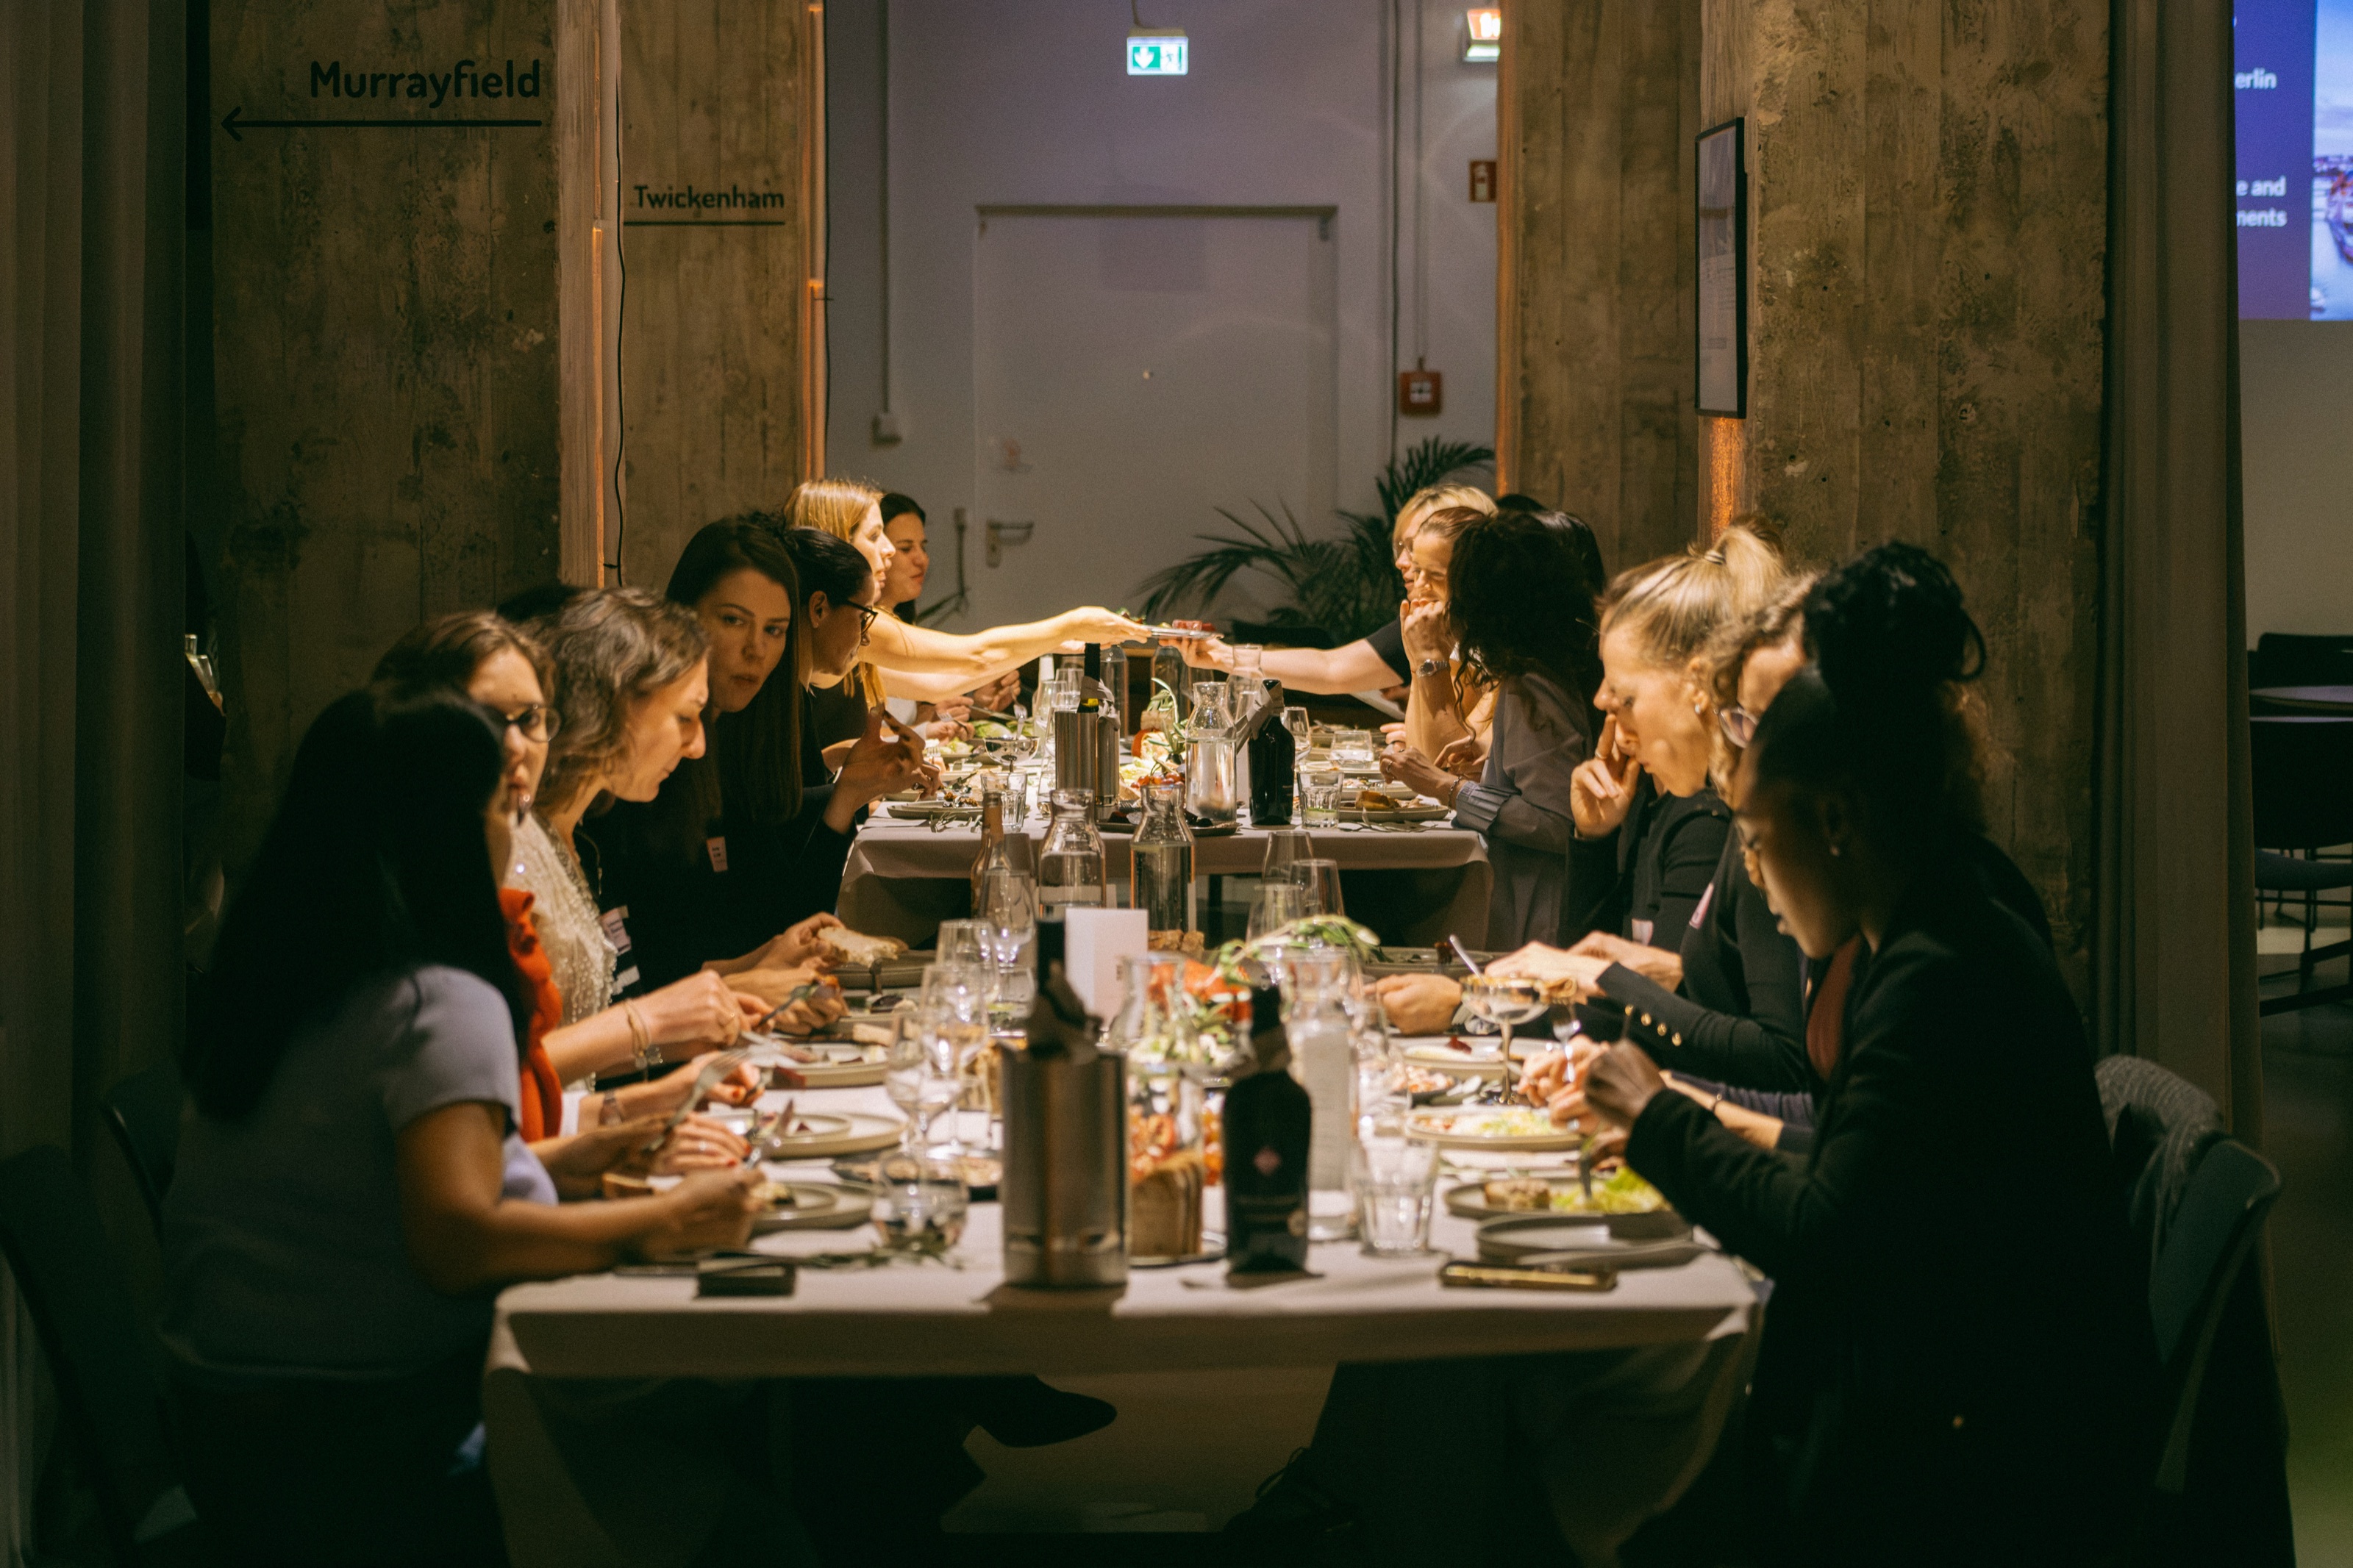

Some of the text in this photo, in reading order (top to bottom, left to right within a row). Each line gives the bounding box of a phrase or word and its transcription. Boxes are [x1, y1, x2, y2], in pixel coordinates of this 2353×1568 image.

[310, 59, 540, 109] Murrayfield
[2235, 68, 2277, 90] erlin
[634, 185, 785, 209] Twickenham
[2251, 176, 2286, 197] and
